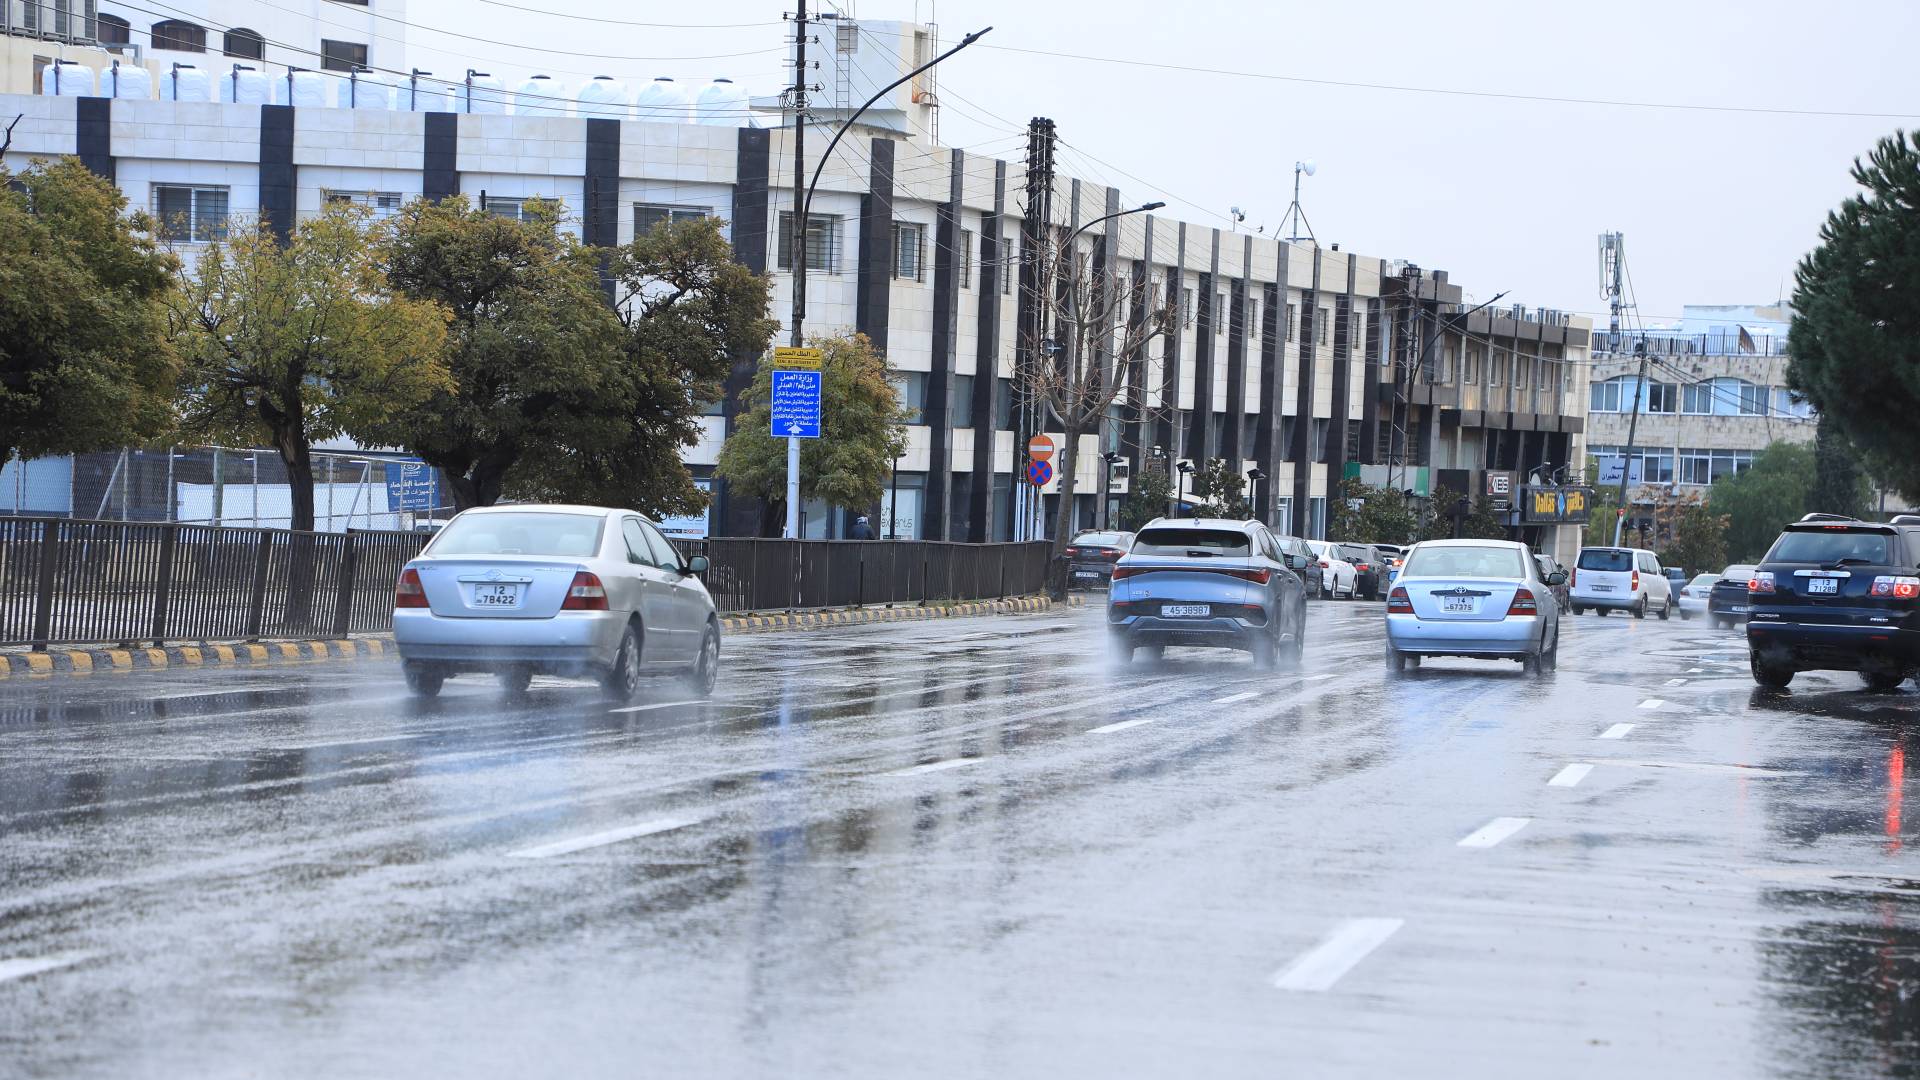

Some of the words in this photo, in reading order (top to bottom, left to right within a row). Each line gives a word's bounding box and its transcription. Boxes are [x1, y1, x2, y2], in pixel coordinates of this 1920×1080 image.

[780, 373, 797, 382] العمل
[798, 374, 813, 382] وزارة
[777, 381, 793, 391] العبدلي
[1601, 472, 1621, 481] الطيران
[1535, 492, 1555, 513] Dallas
[493, 586, 505, 595] 12
[483, 595, 515, 604] 78422
[1449, 603, 1472, 611] 67375
